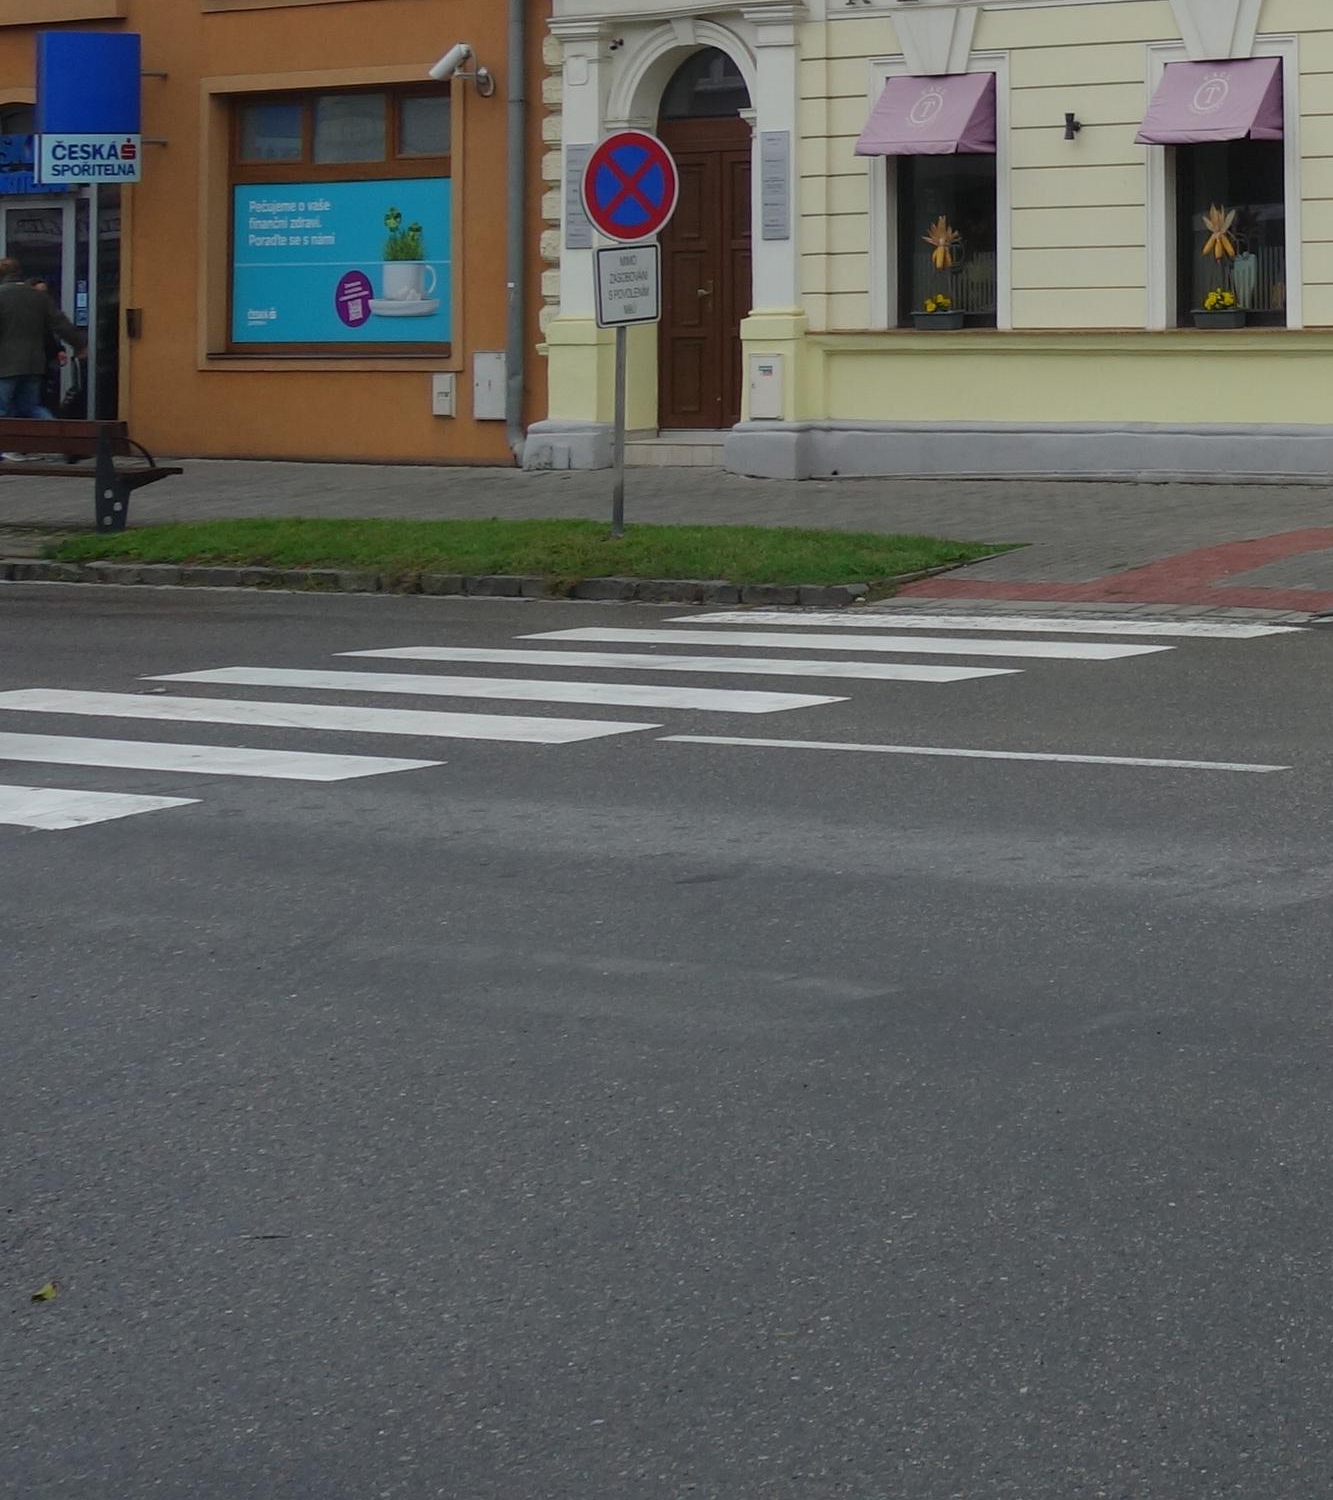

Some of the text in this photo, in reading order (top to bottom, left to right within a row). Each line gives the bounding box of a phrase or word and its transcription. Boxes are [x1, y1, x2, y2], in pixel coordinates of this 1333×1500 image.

[51, 141, 119, 161] ČESKÁ
[51, 162, 136, 177] SPOŘITELNA
[249, 199, 331, 214] Pečujeme o vaše
[288, 236, 301, 246] se
[302, 236, 309, 246] s
